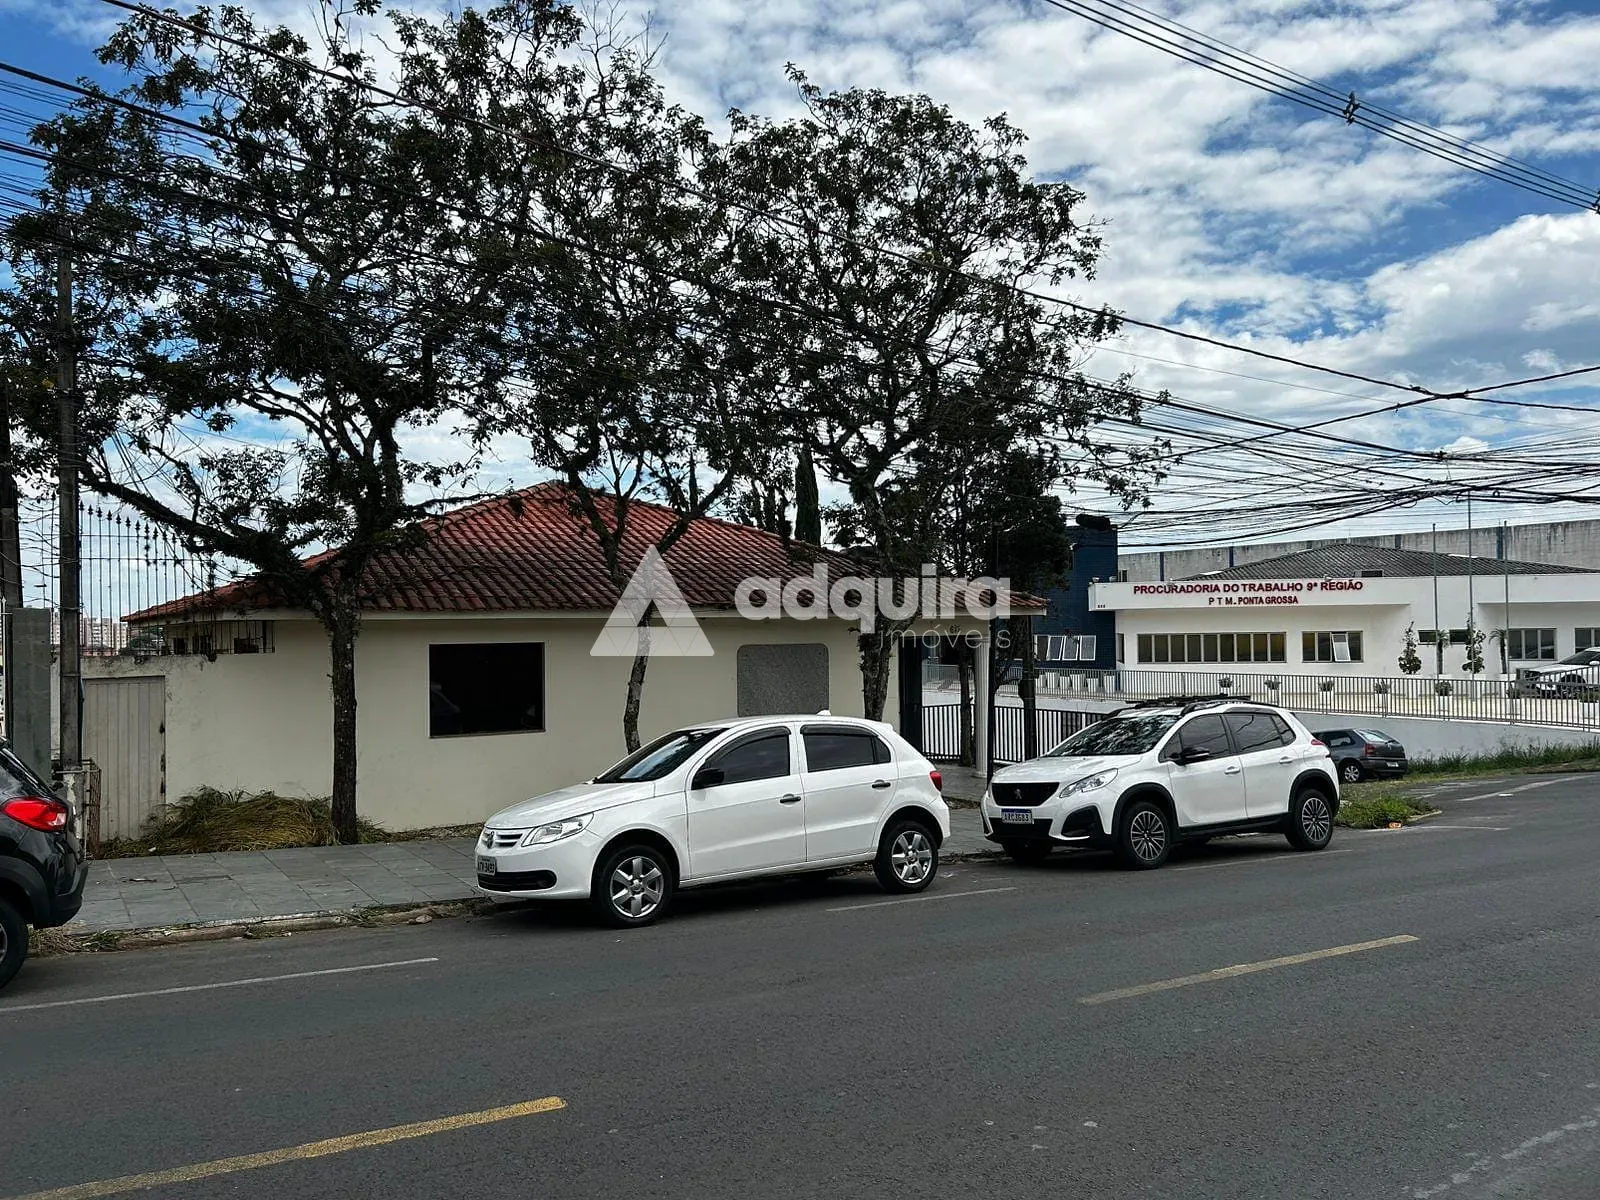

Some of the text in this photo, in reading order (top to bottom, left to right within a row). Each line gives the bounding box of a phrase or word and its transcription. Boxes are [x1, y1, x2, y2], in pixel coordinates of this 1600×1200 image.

[1133, 583, 1221, 594] PROCURADORIA
[1223, 584, 1240, 593] DO
[1241, 582, 1304, 592] TRABALHO
[1320, 579, 1364, 591] REGIÃO
[1238, 596, 1265, 605] PONTA
[1265, 595, 1299, 605] GROSSA
